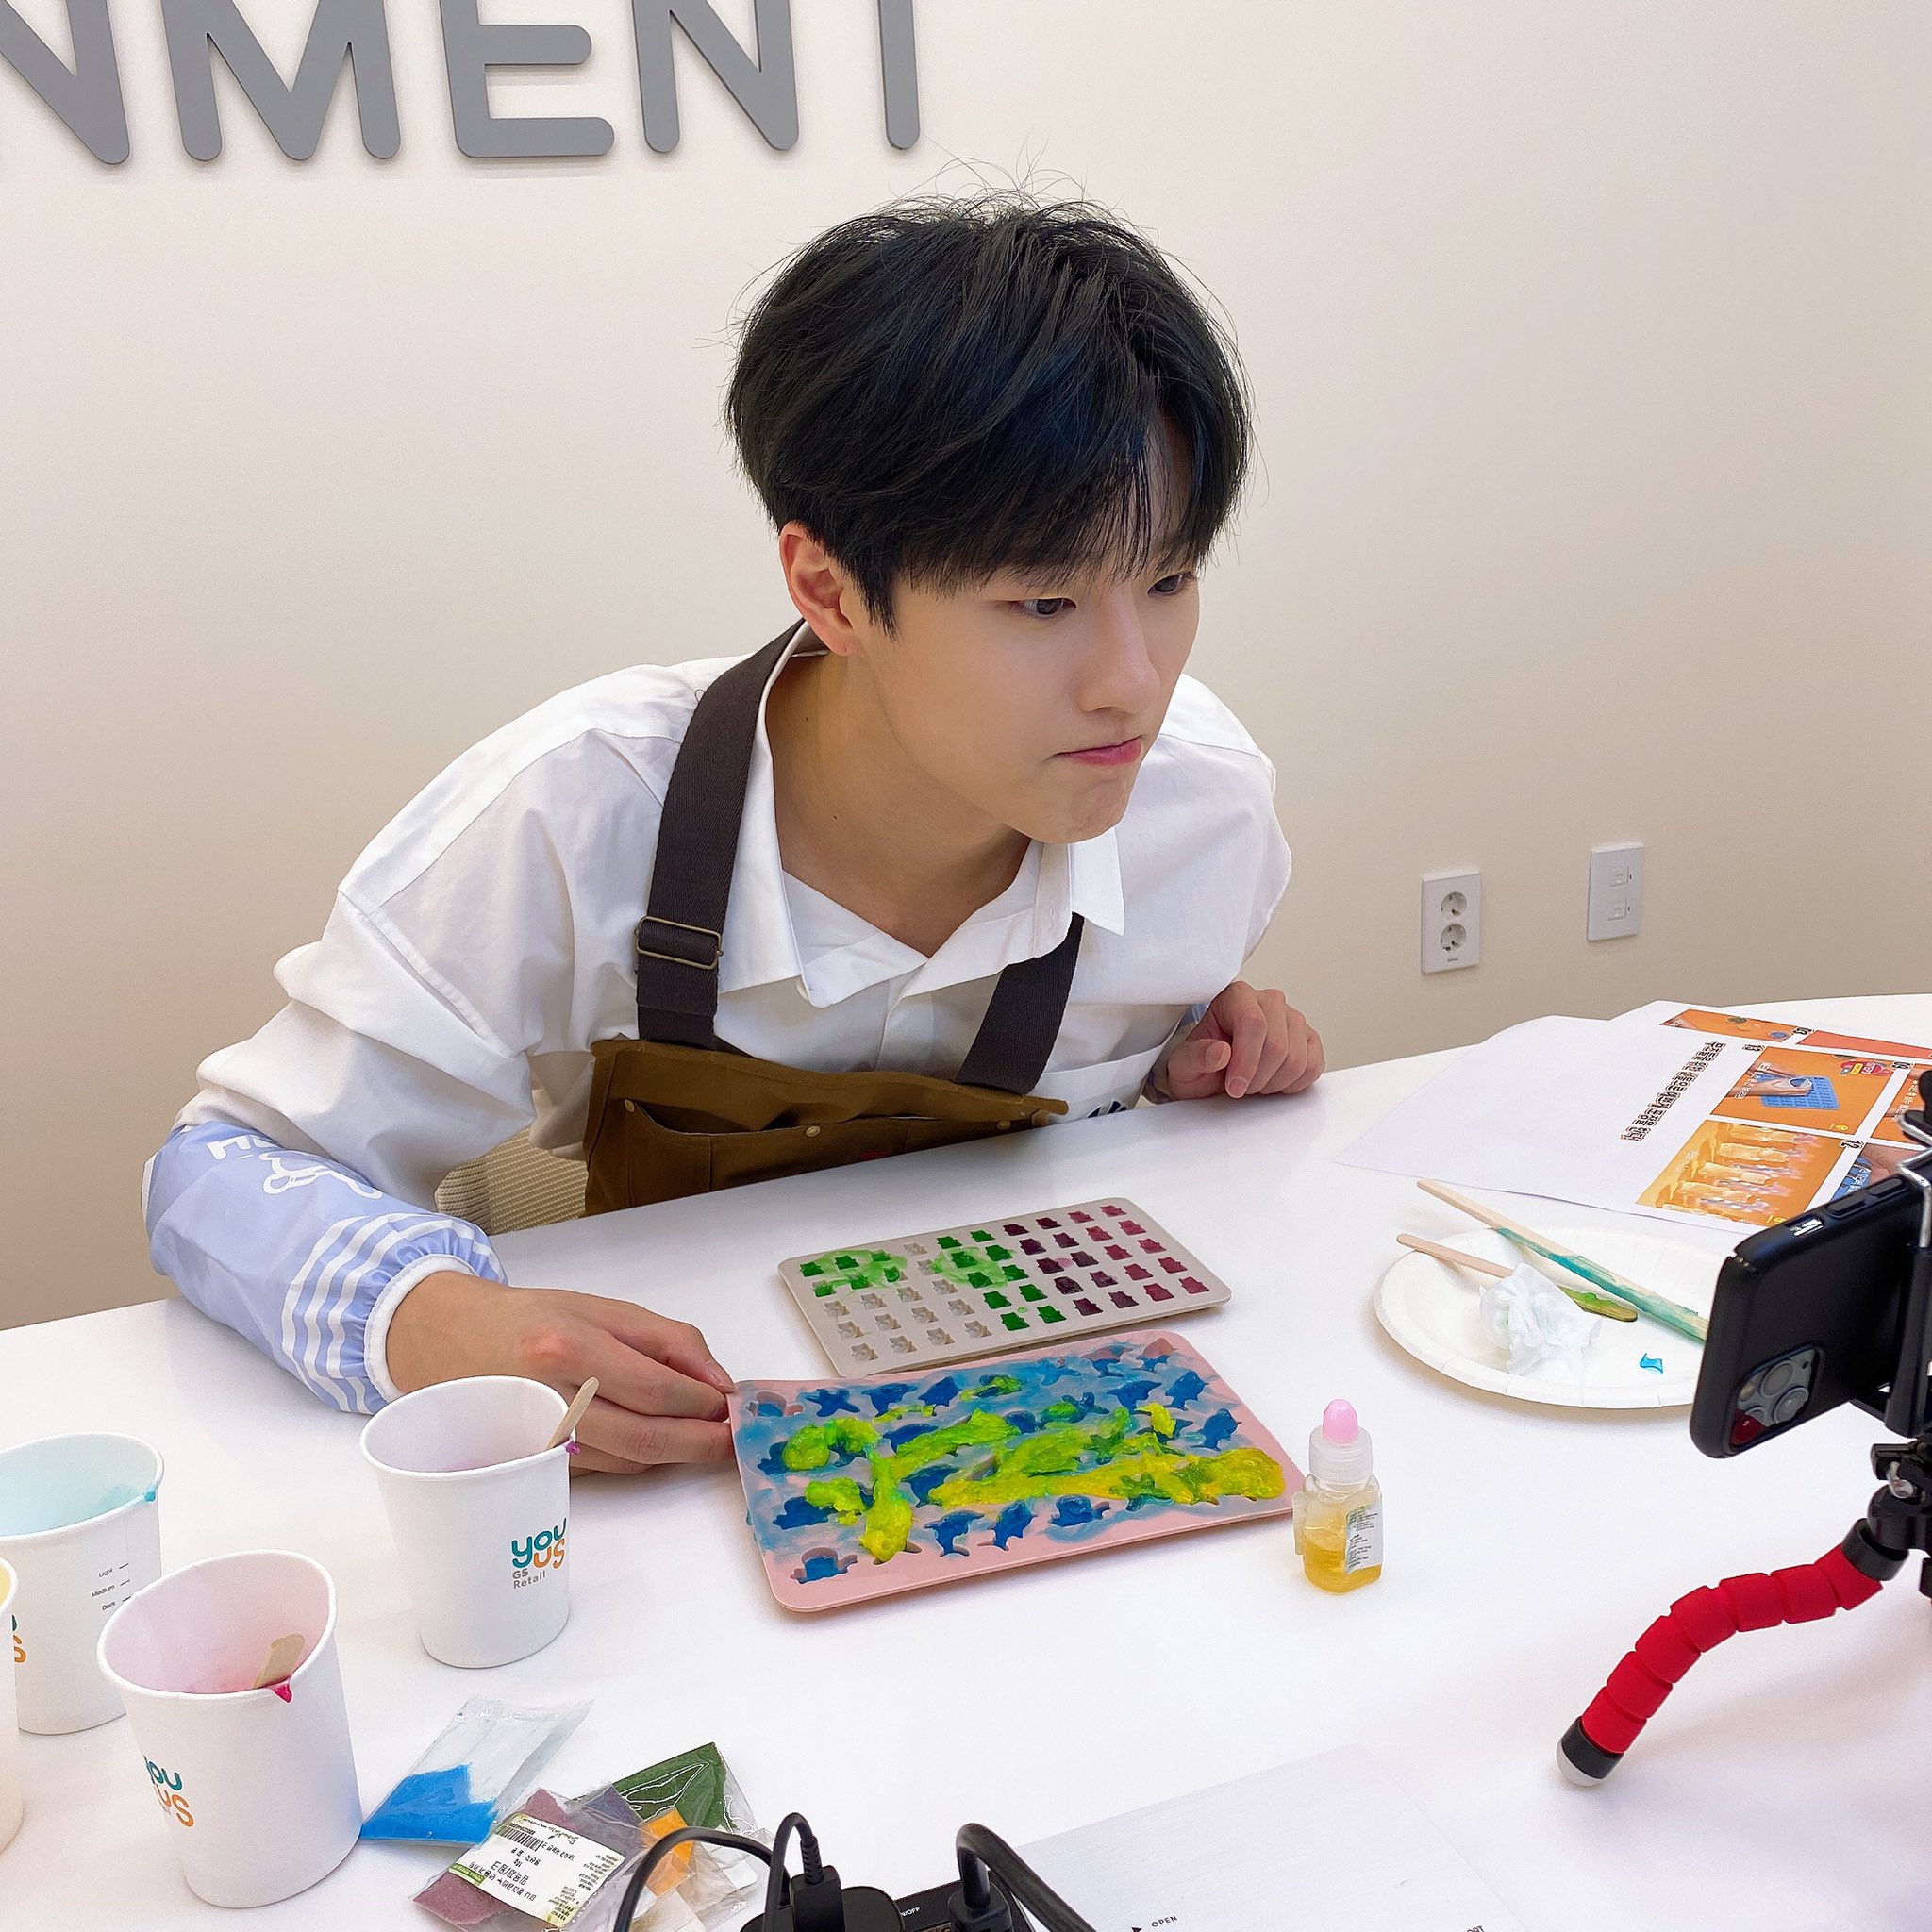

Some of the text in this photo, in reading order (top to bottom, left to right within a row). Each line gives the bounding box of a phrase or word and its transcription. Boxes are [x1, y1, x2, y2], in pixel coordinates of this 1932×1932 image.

[1742, 1043, 1766, 1053] 13
[1683, 1060, 1708, 1072] 위한
[1648, 1091, 1681, 1109] 예쁘게
[1633, 1107, 1667, 1126] 포장을
[1840, 1138, 1865, 1150] 12
[511, 1517, 567, 1569] you
[98, 1568, 113, 1578] Light
[512, 1568, 529, 1580] GS
[513, 1570, 546, 1590] Retail
[91, 1585, 115, 1598] Medium
[101, 1601, 116, 1611] Dark
[513, 1858, 523, 1868] 10g
[524, 1891, 537, 1902] 미니
[1151, 1915, 1178, 1927] OPEN
